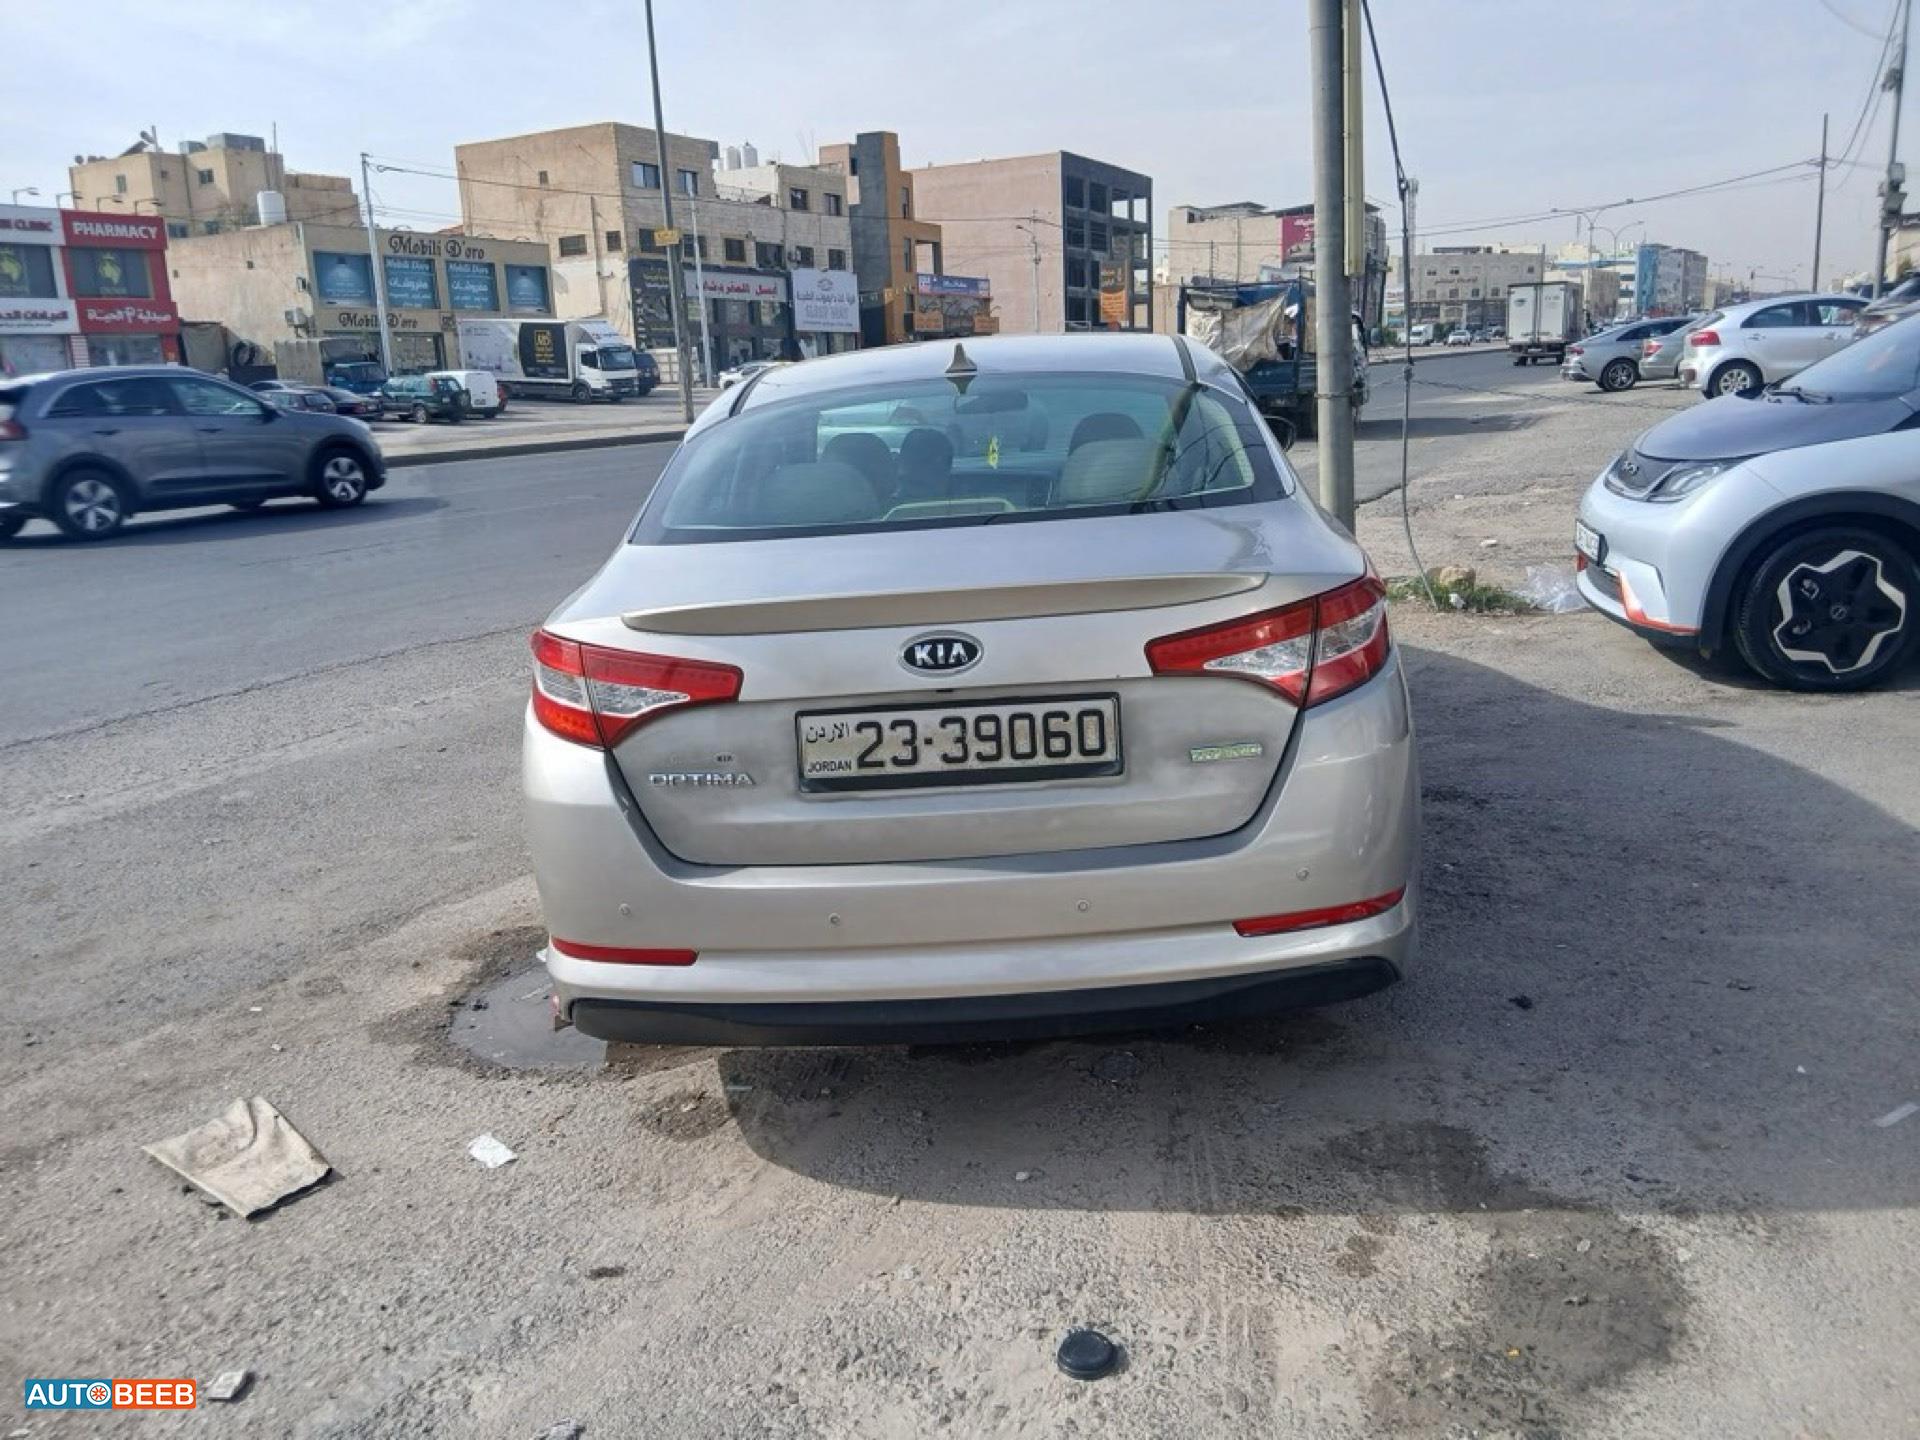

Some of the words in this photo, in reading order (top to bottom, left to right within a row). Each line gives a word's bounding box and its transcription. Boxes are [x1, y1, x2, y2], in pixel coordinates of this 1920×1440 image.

[72, 221, 158, 240] PHARMACY
[387, 235, 441, 256] Mobili
[338, 312, 380, 328] Mobil
[914, 641, 969, 667] KIA
[855, 708, 1107, 770] 23-39060
[807, 760, 852, 774] JORDAN
[648, 772, 755, 786] OPTIMA
